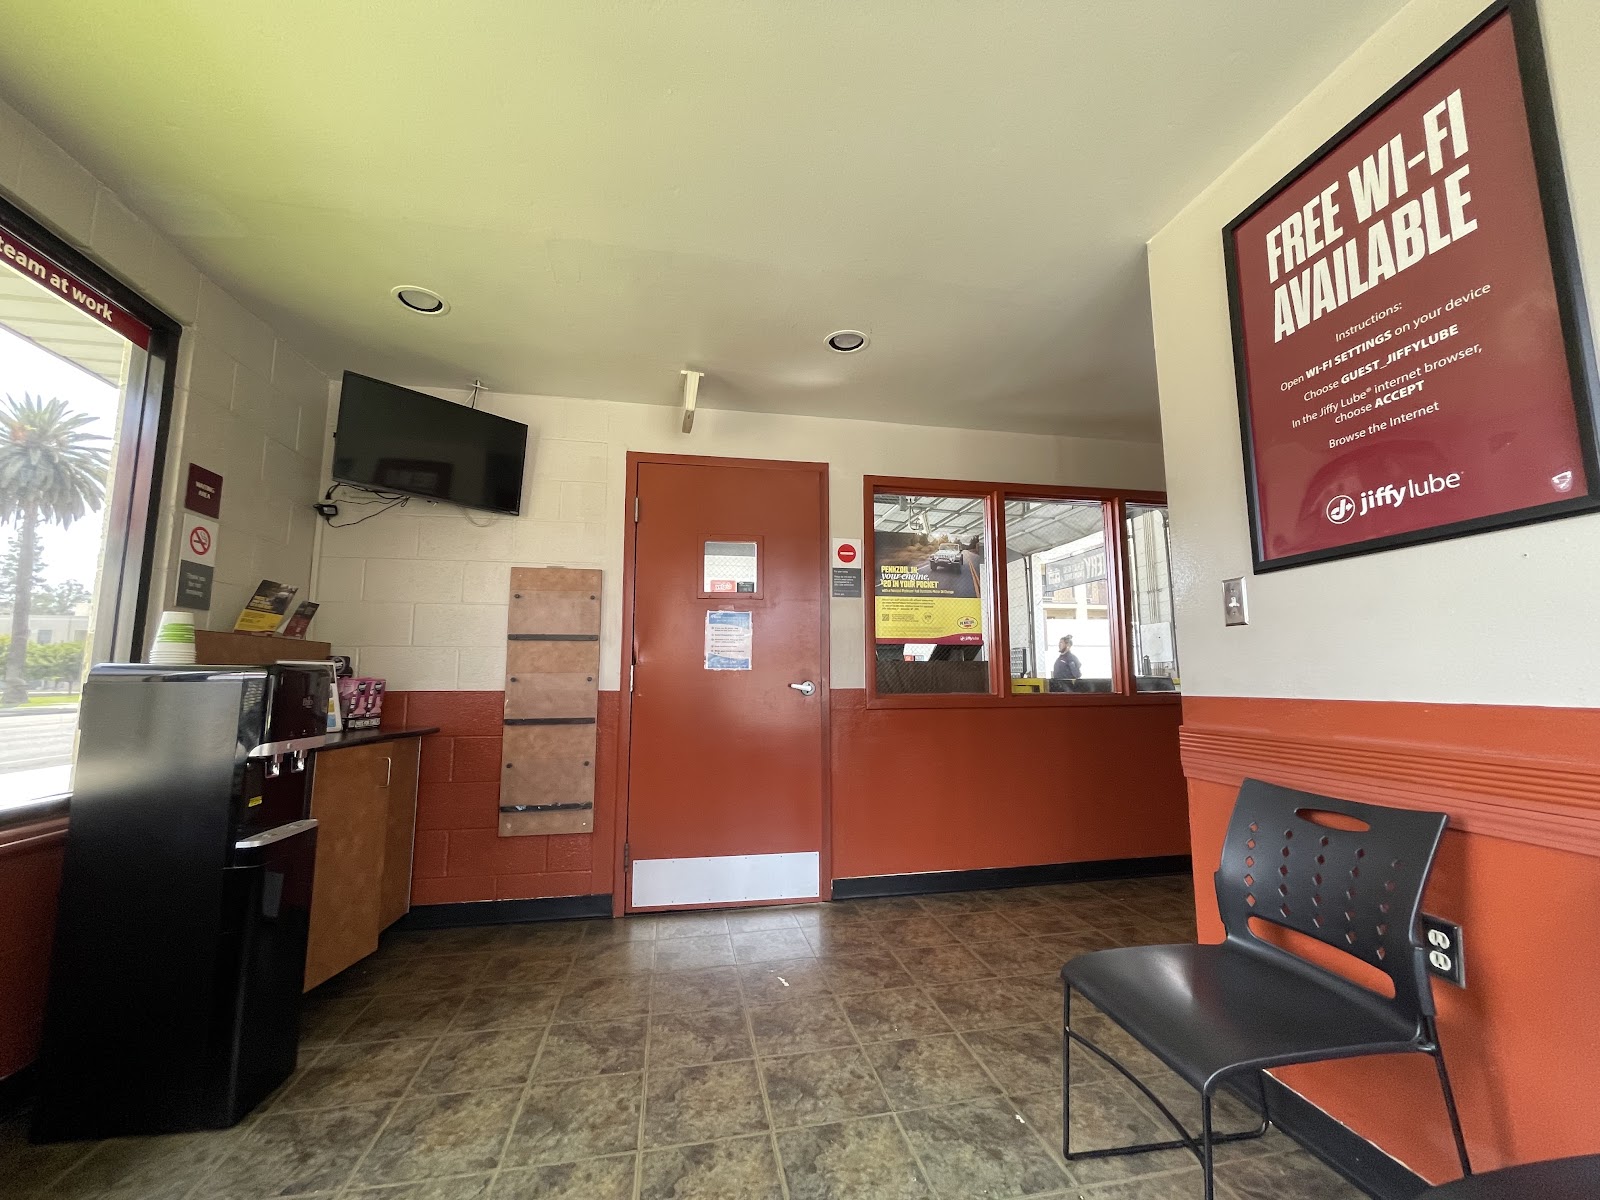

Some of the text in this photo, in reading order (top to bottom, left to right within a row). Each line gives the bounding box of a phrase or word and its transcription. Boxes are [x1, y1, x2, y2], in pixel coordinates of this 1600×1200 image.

[1266, 88, 1469, 284] FREE WI-FI
[1274, 163, 1478, 343] AVAILABLE
[49, 273, 70, 294] at
[72, 286, 113, 322] work
[1335, 302, 1403, 342] Instructions:
[1280, 284, 1491, 392] Open WI-FI SETTINGS on your device
[1303, 324, 1459, 401] Choose GUEST_JIFFYLUBE
[1292, 419, 1301, 429] In
[1302, 412, 1318, 425] the
[1319, 402, 1339, 419] Jiffy
[1374, 367, 1422, 393] internet
[1424, 343, 1483, 373] browser,
[1334, 380, 1425, 424] choose ACCEPT
[1329, 402, 1440, 449] Browse the Internet
[881, 573, 901, 581] your
[892, 580, 899, 588] IN
[900, 580, 915, 588] YOUR
[916, 580, 939, 588] POCKET
